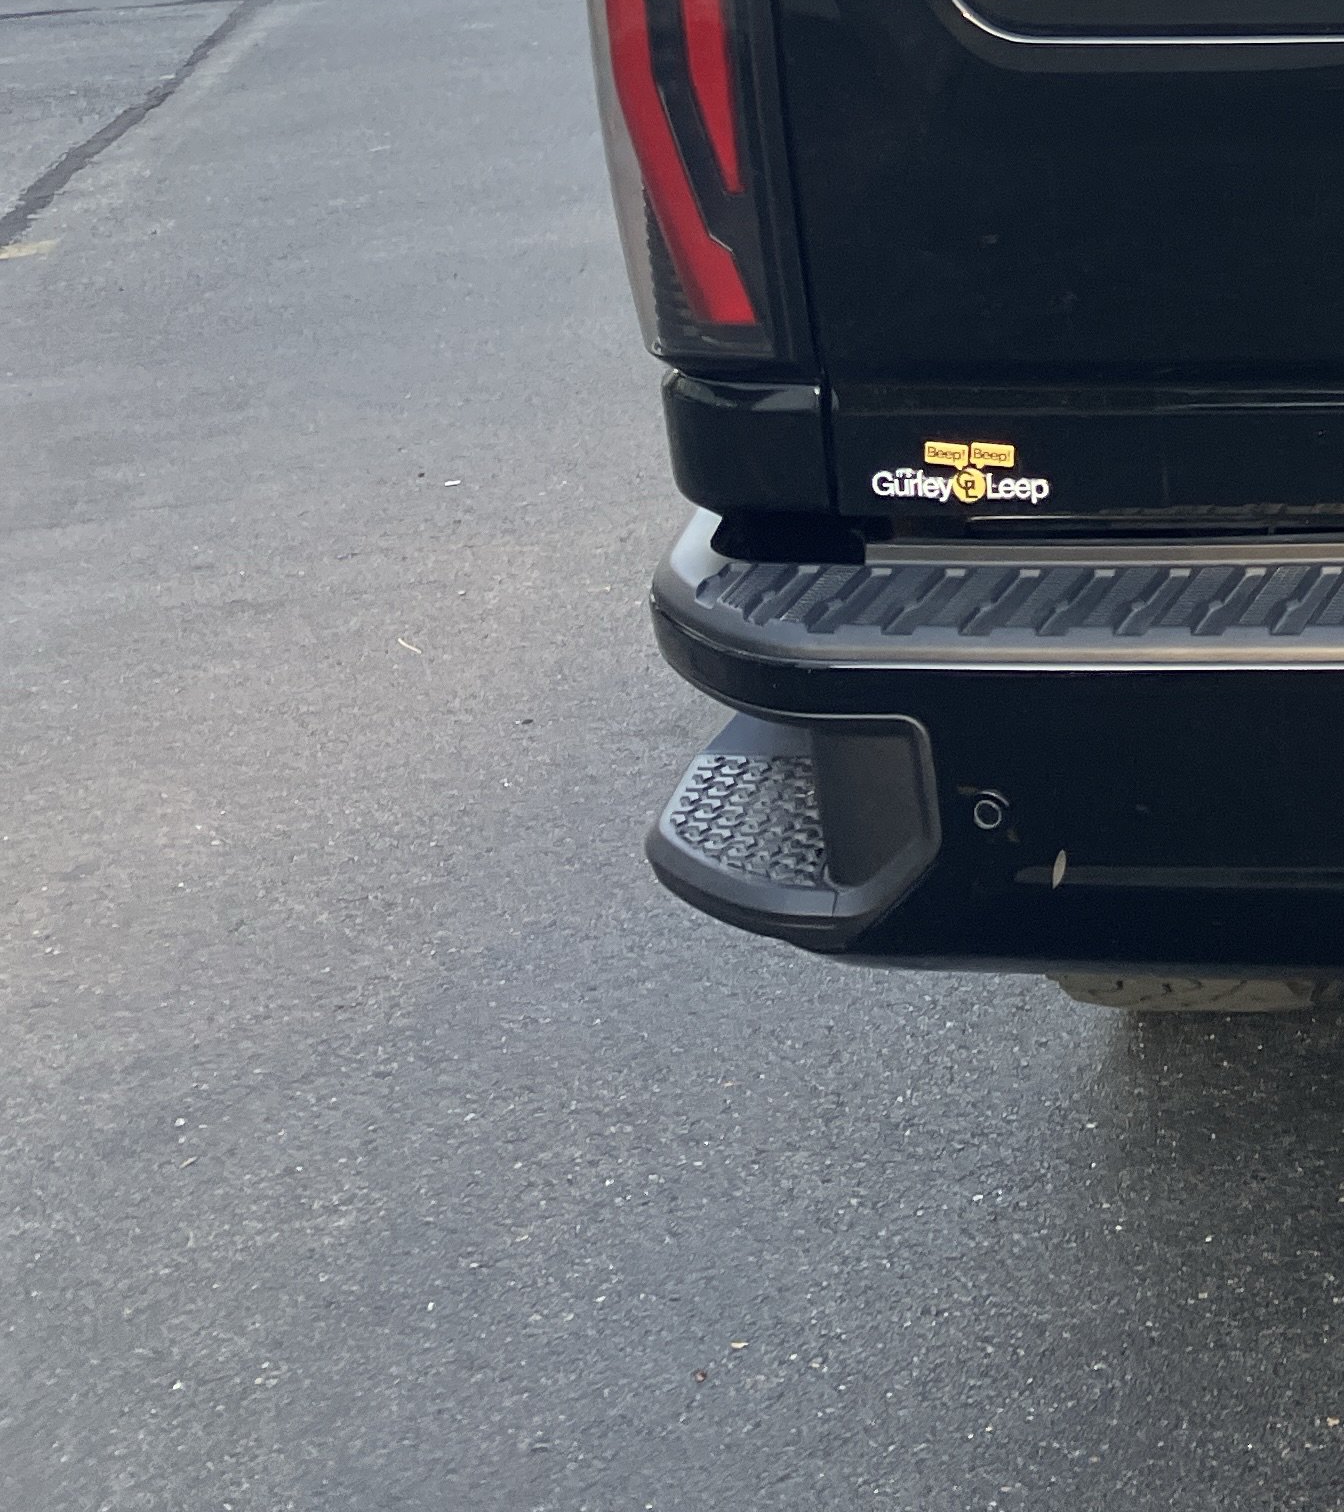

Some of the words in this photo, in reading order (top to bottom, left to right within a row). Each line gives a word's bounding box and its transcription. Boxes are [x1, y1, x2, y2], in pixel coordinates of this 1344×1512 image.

[927, 445, 966, 461] Beep!
[973, 447, 1011, 463] Beep!
[986, 472, 1050, 505] Leep
